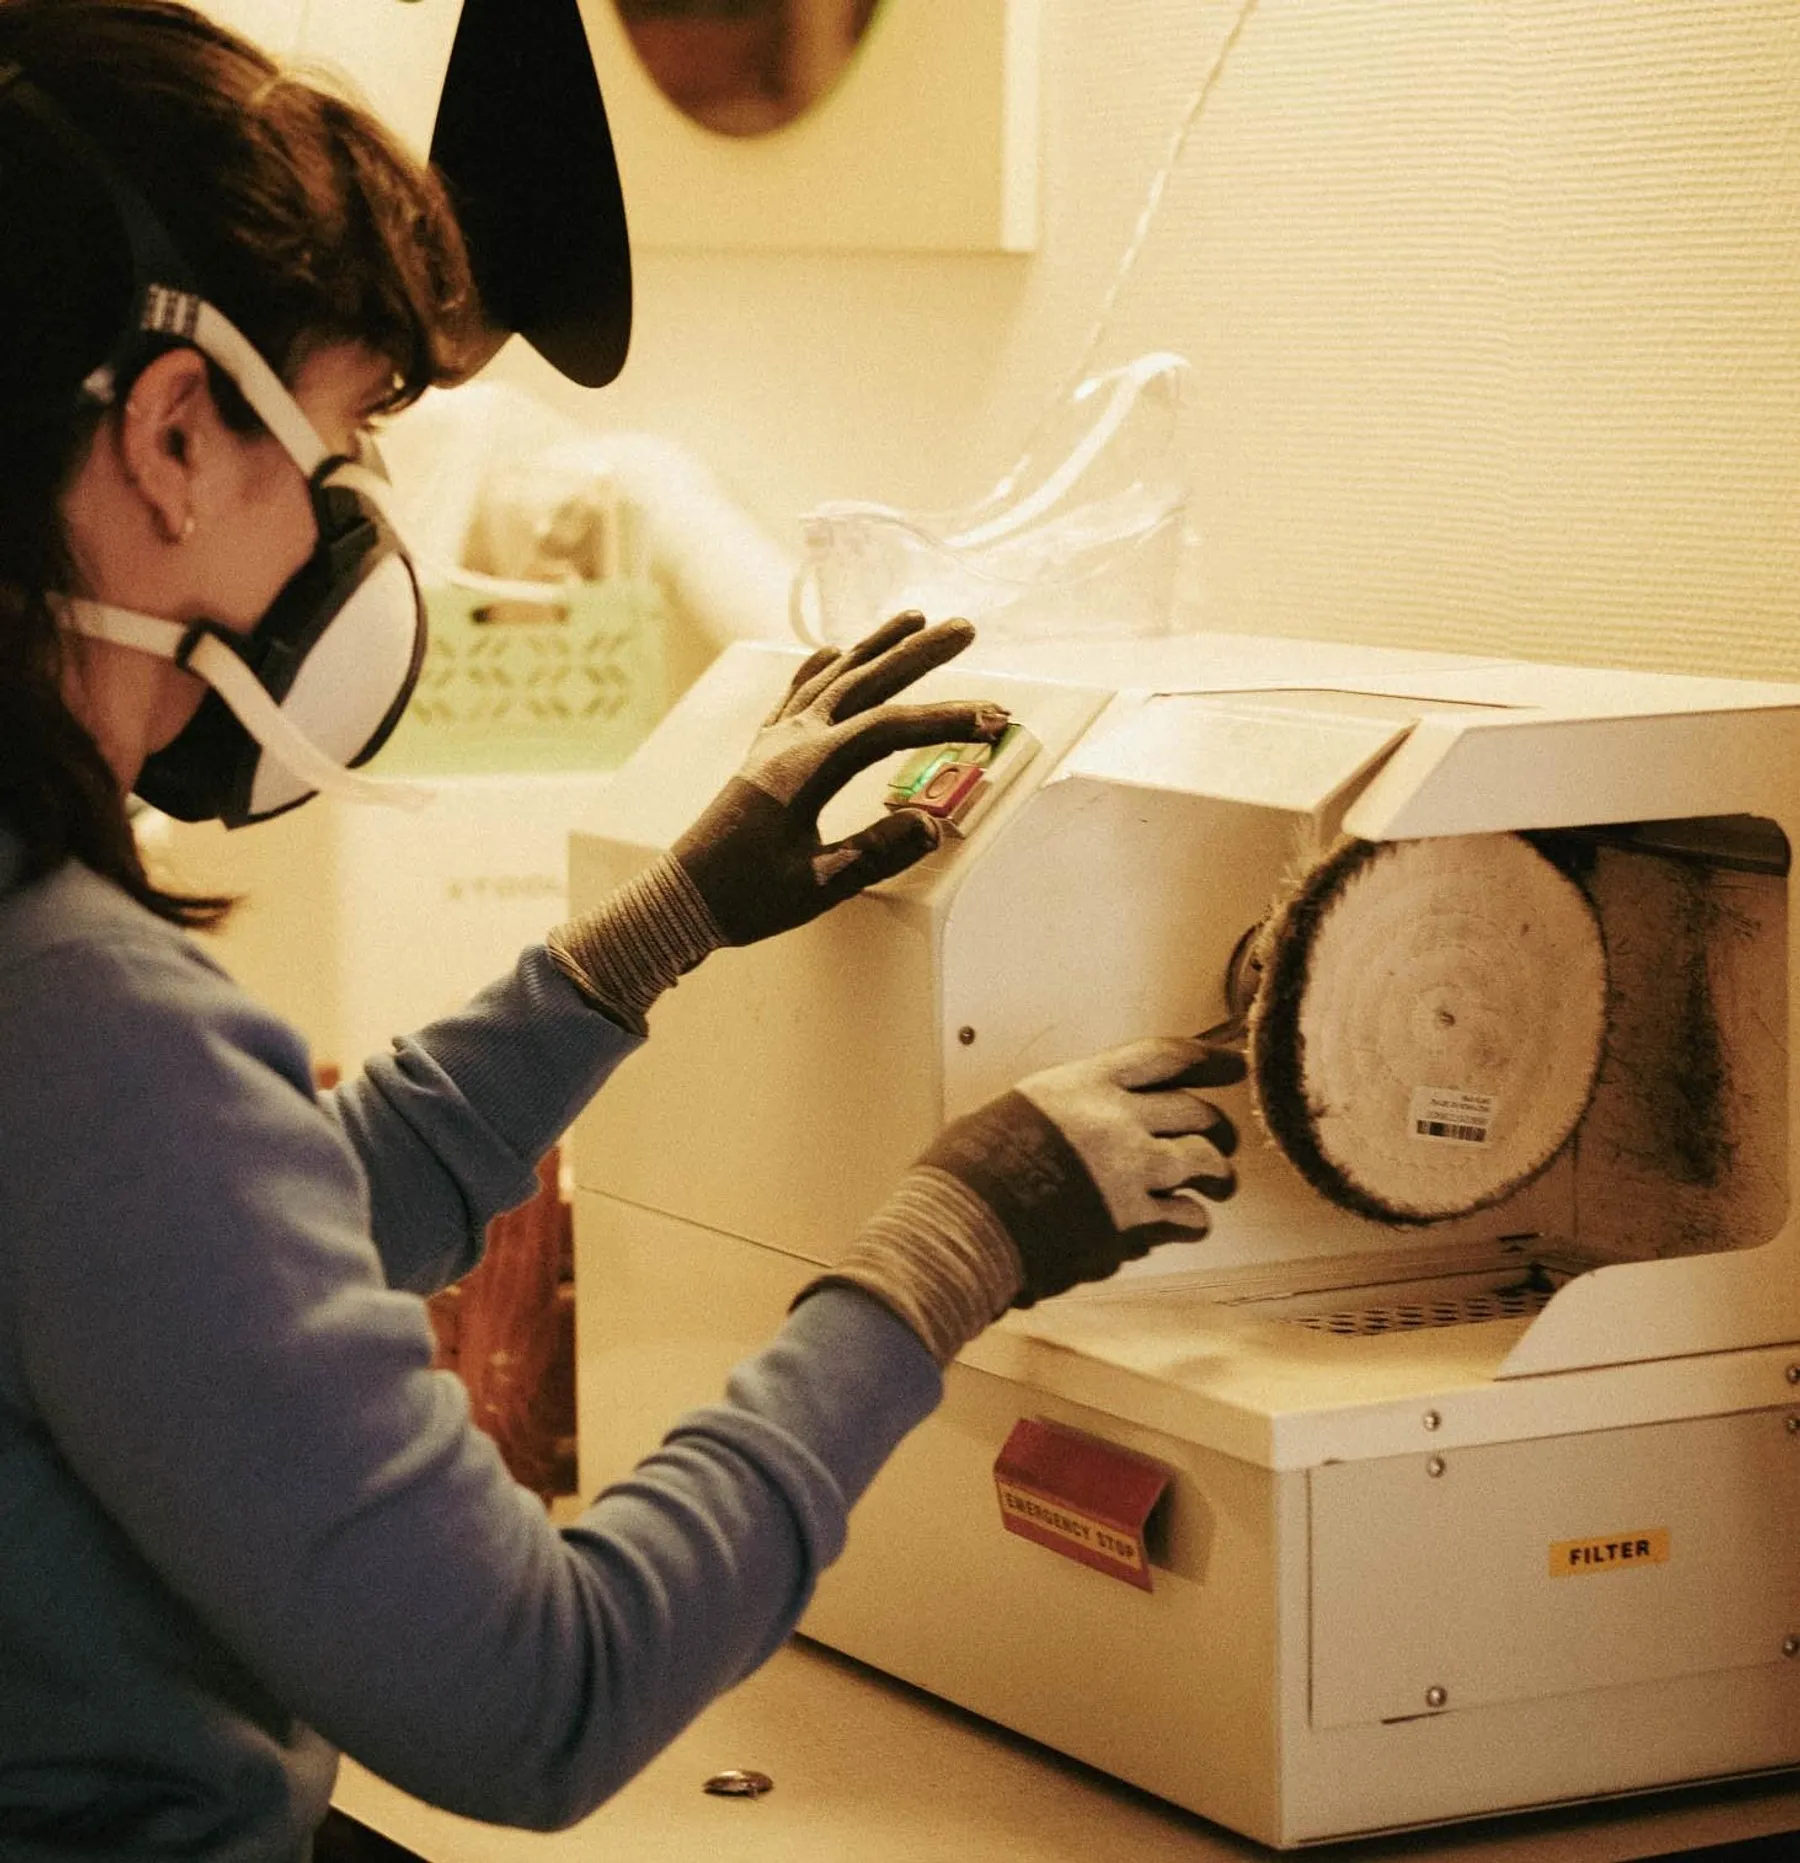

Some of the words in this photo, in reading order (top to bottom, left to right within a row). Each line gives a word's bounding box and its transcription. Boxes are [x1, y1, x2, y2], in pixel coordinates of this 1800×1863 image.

[1005, 1492, 1092, 1540] EMERGENCY
[1096, 1531, 1134, 1559] STOP
[1569, 1539, 1650, 1566] FILTER
